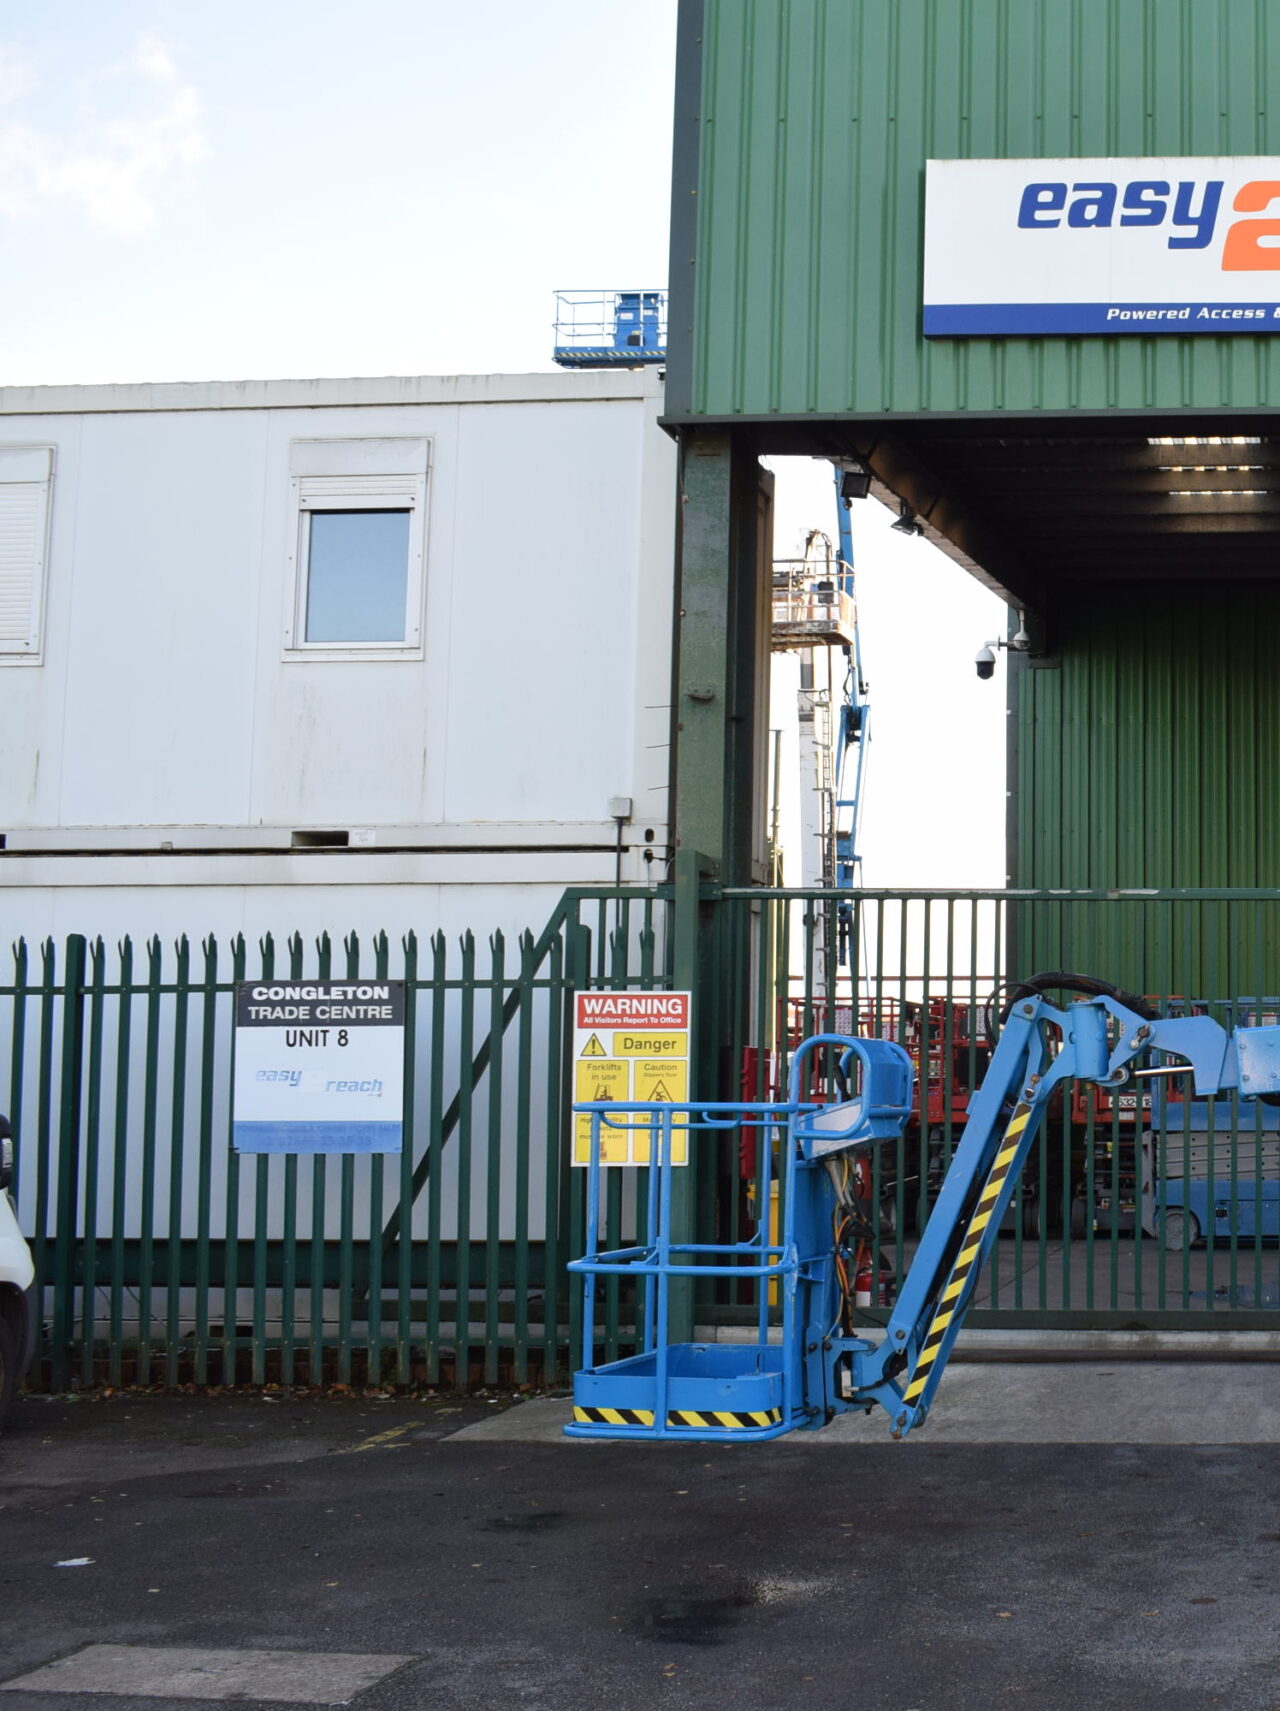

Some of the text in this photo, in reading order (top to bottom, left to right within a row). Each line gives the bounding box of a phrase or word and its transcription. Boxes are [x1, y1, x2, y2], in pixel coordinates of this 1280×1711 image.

[1106, 308, 1190, 320] Powered
[1197, 307, 1266, 319] Access
[252, 986, 389, 1000] CONGLETON
[248, 1006, 393, 1019] TRADE CENTRE
[583, 998, 683, 1014] WARNING
[286, 1029, 349, 1047] UNIT 8
[623, 1037, 677, 1053] Danger
[587, 1063, 622, 1071] Forklifts
[644, 1063, 677, 1071] Caution
[326, 1079, 383, 1092] reach
